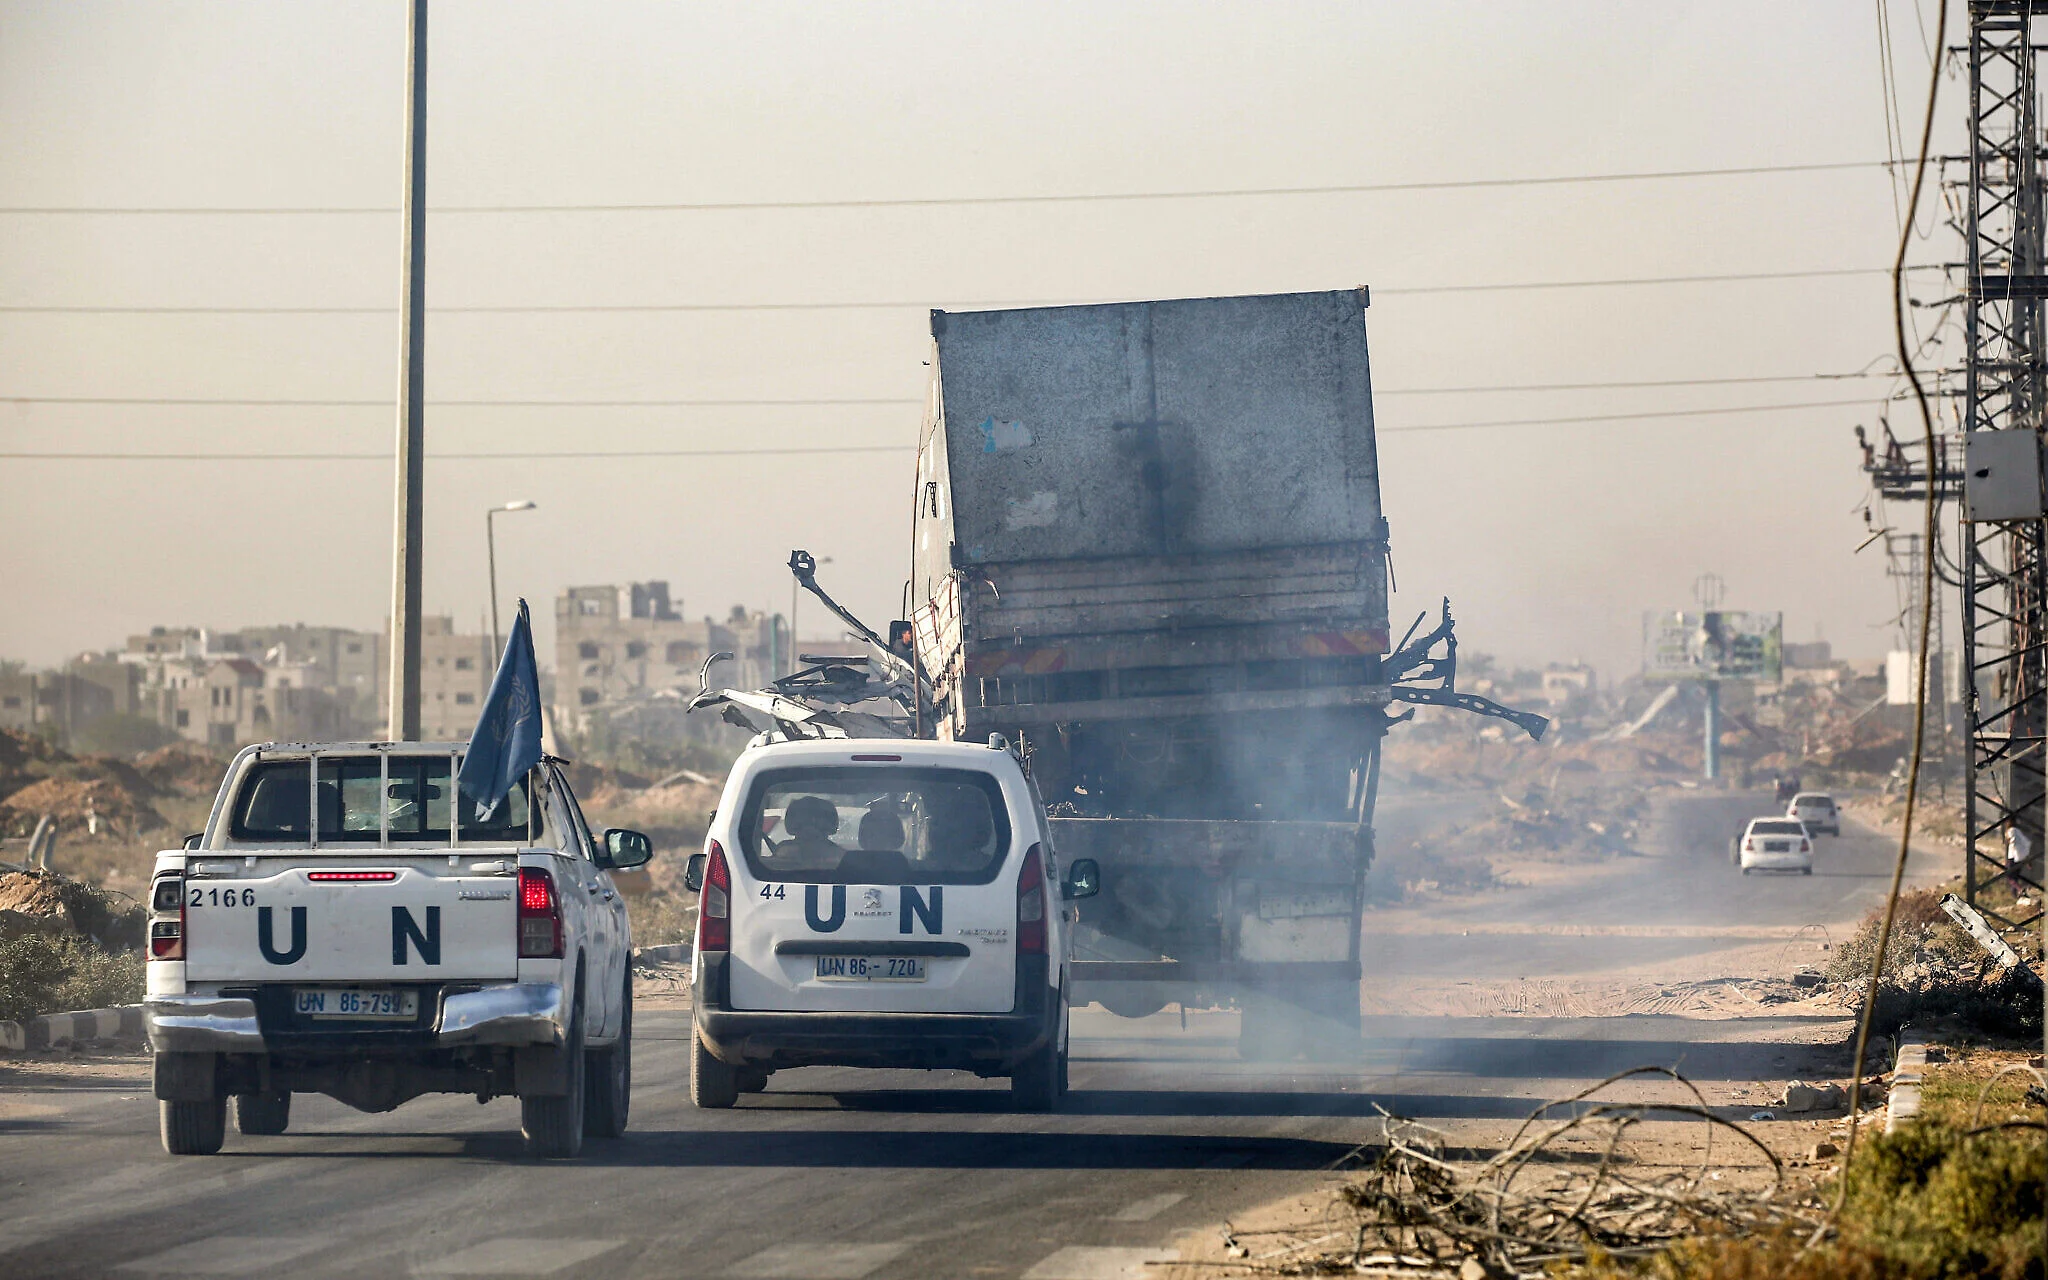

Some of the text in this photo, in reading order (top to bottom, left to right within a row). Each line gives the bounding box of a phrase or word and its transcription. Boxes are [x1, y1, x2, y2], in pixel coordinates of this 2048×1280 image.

[190, 888, 255, 907] 2166
[760, 884, 786, 900] 44
[804, 884, 943, 935] U N
[257, 906, 441, 966] U N
[821, 957, 845, 976] UN
[298, 992, 325, 1012] UN
